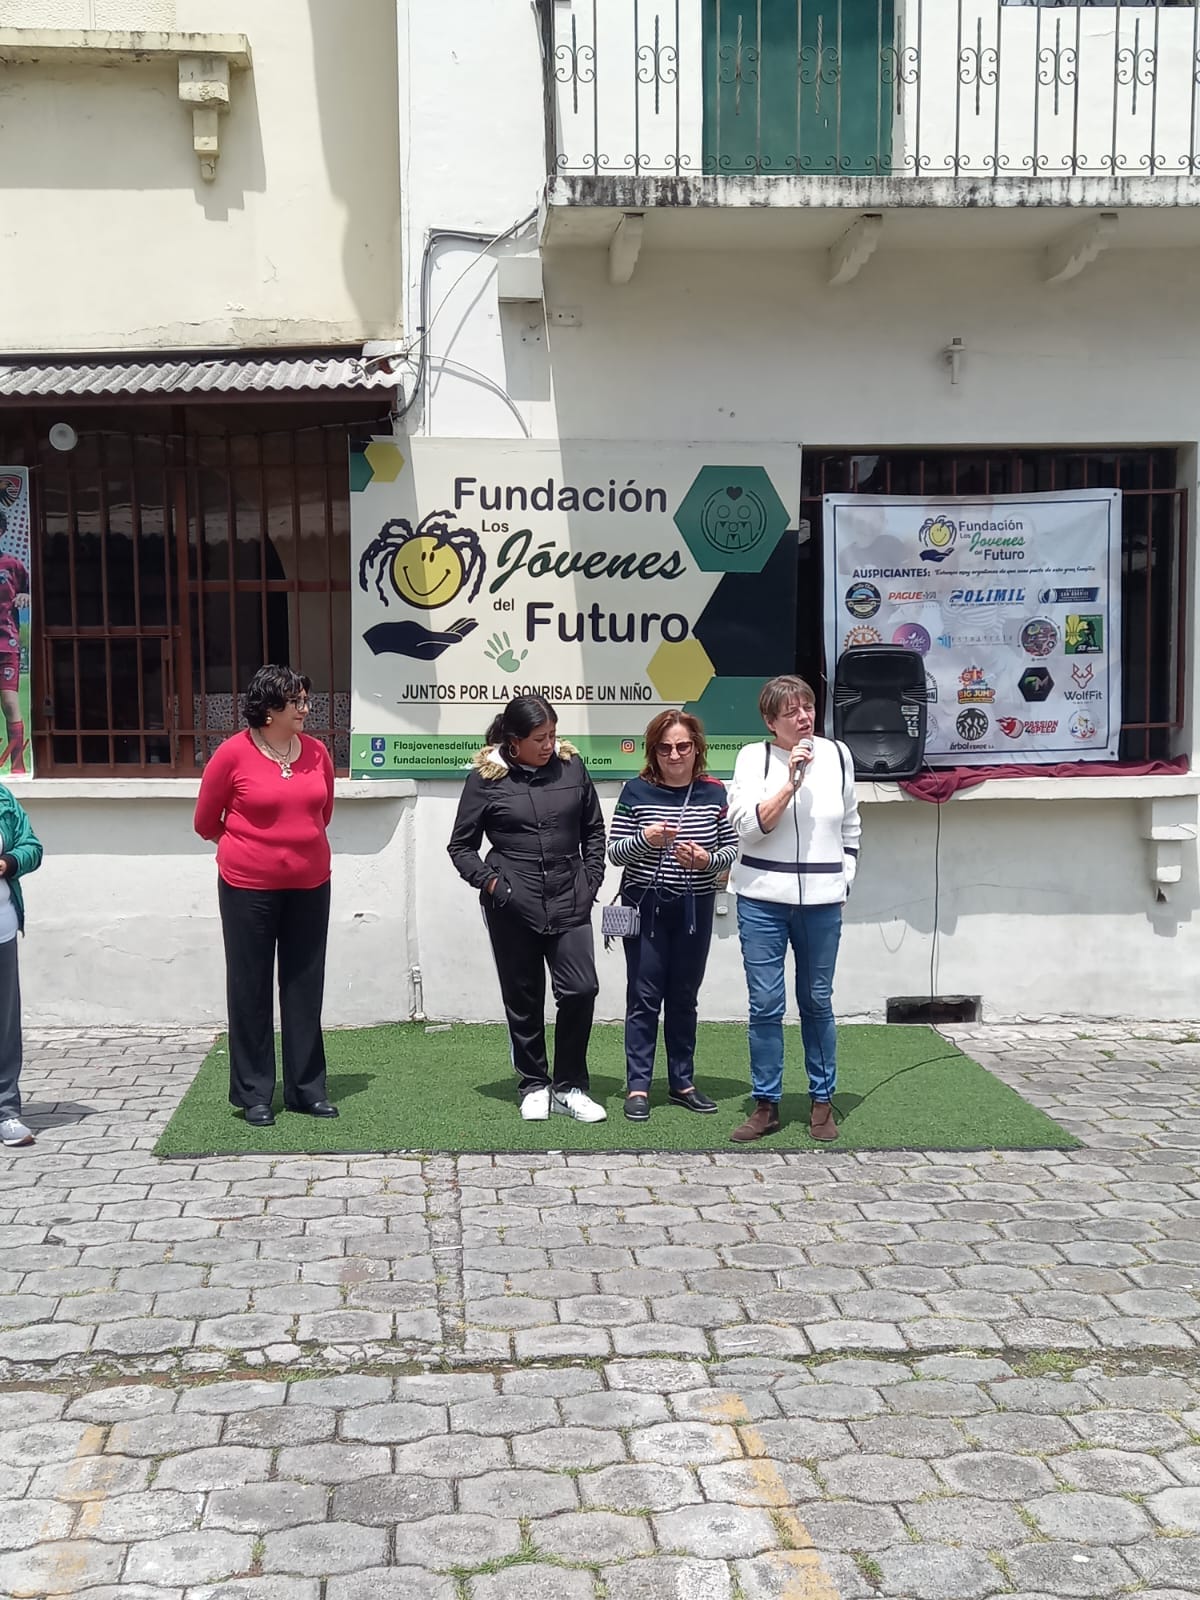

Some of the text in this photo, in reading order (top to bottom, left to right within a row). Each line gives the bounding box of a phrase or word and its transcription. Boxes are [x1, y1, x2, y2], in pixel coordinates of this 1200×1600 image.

[453, 477, 667, 513] Fundación
[481, 519, 509, 533] Los
[958, 519, 1023, 532] Fundación
[489, 529, 687, 594] Jóvenes
[984, 549, 1025, 561] Futuro
[853, 568, 931, 579] AUSPICIANTES:
[493, 598, 689, 643] del Futuro
[402, 682, 653, 700] JUNTOS POR LA SONRISA DE UN NIÑO
[1063, 690, 1103, 701] WolfFit
